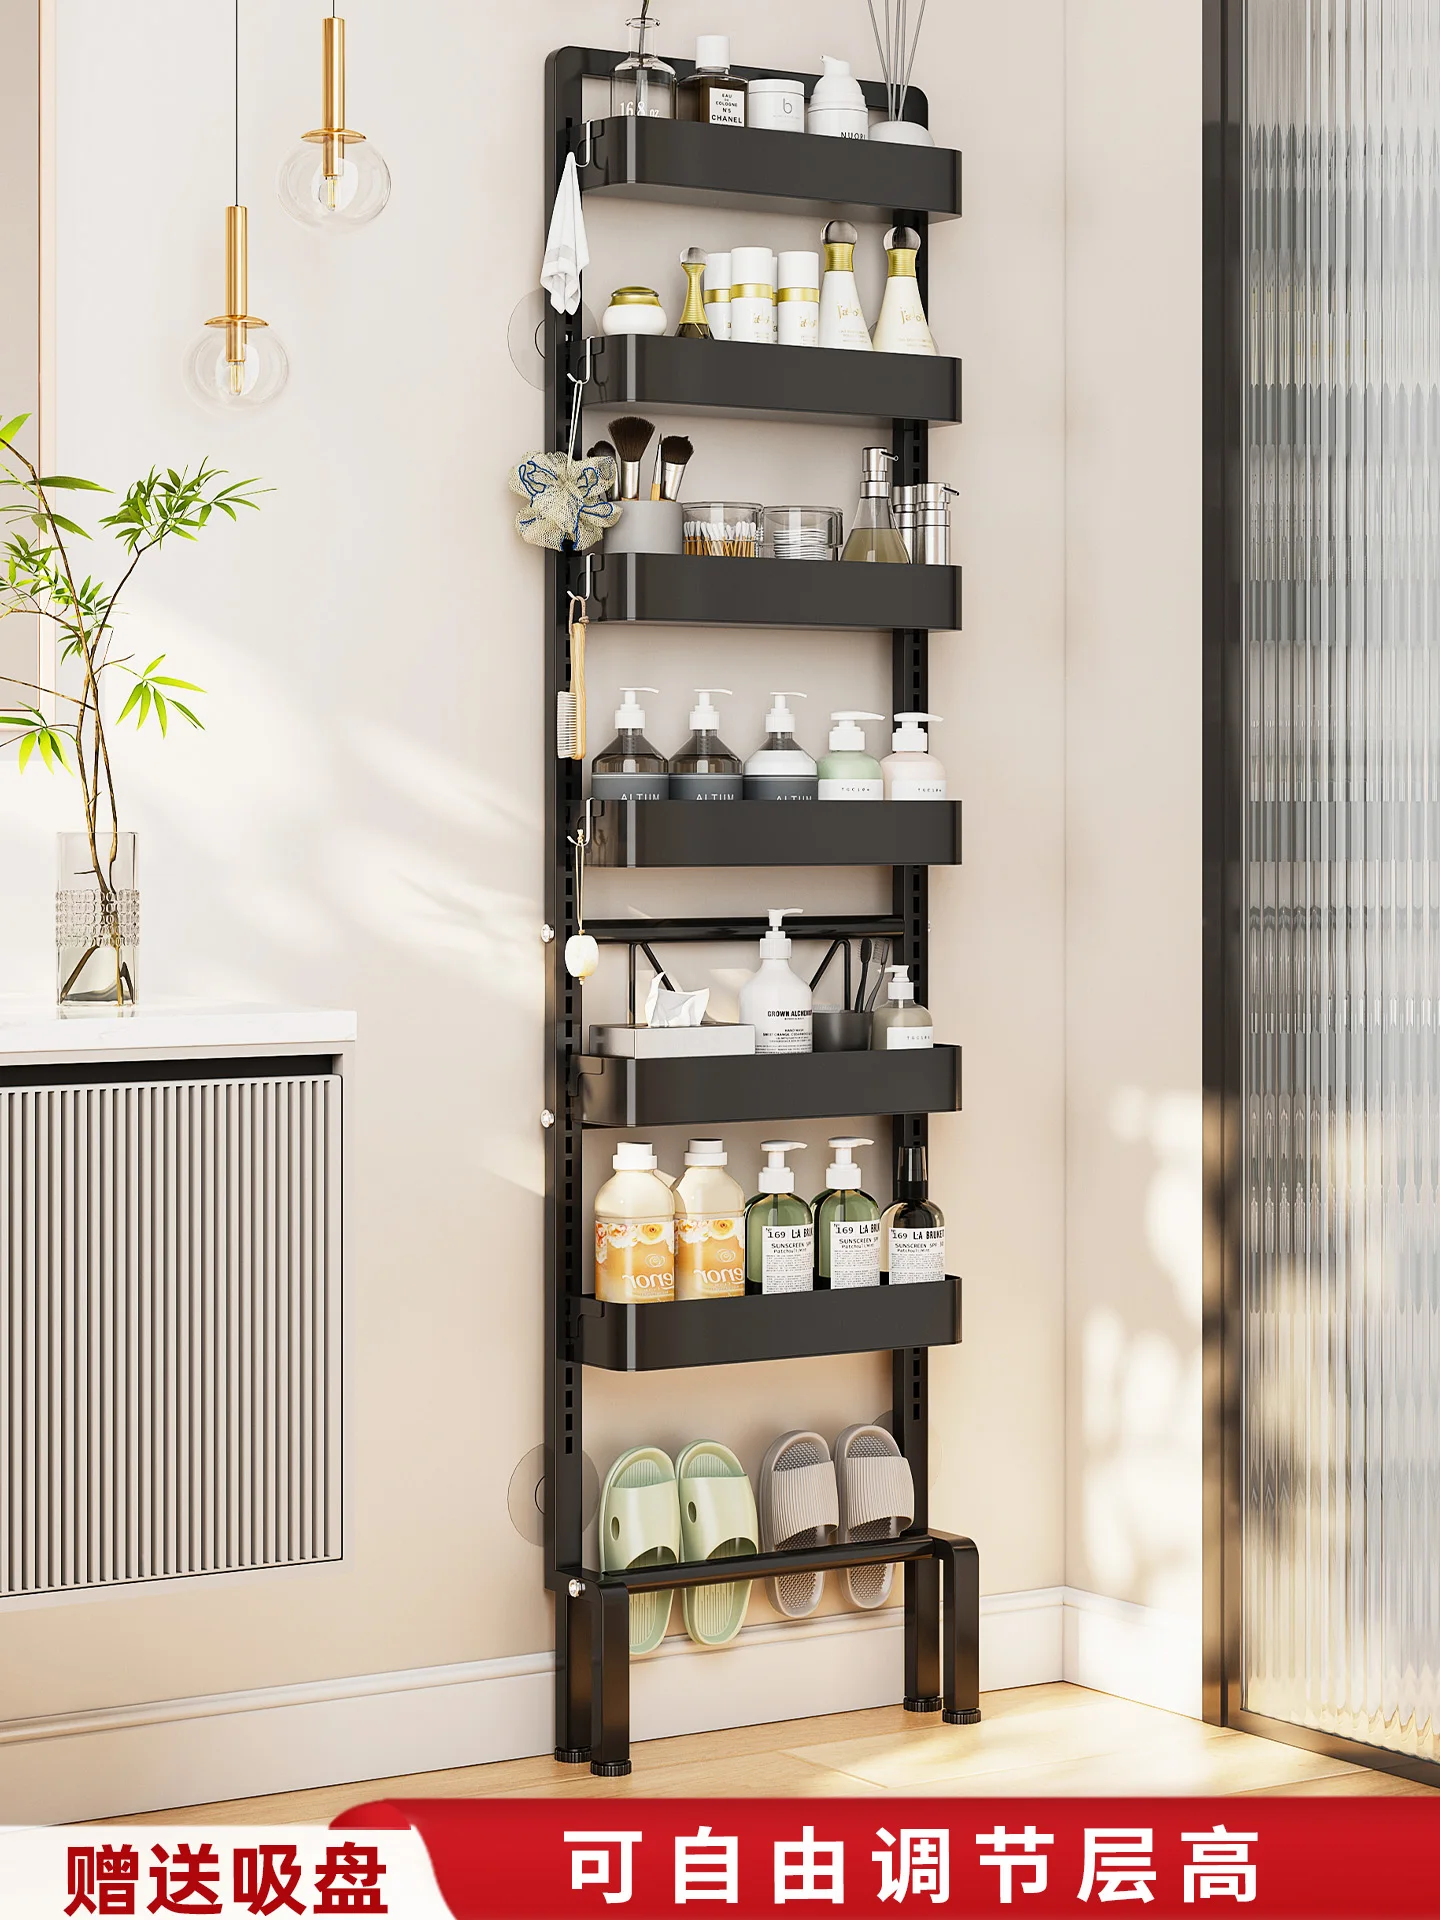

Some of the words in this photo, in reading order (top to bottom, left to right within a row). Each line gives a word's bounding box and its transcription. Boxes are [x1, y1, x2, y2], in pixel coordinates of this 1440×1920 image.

[711, 114, 743, 124] CHANEL
[835, 1226, 854, 1234] 169
[767, 1231, 786, 1239] 169
